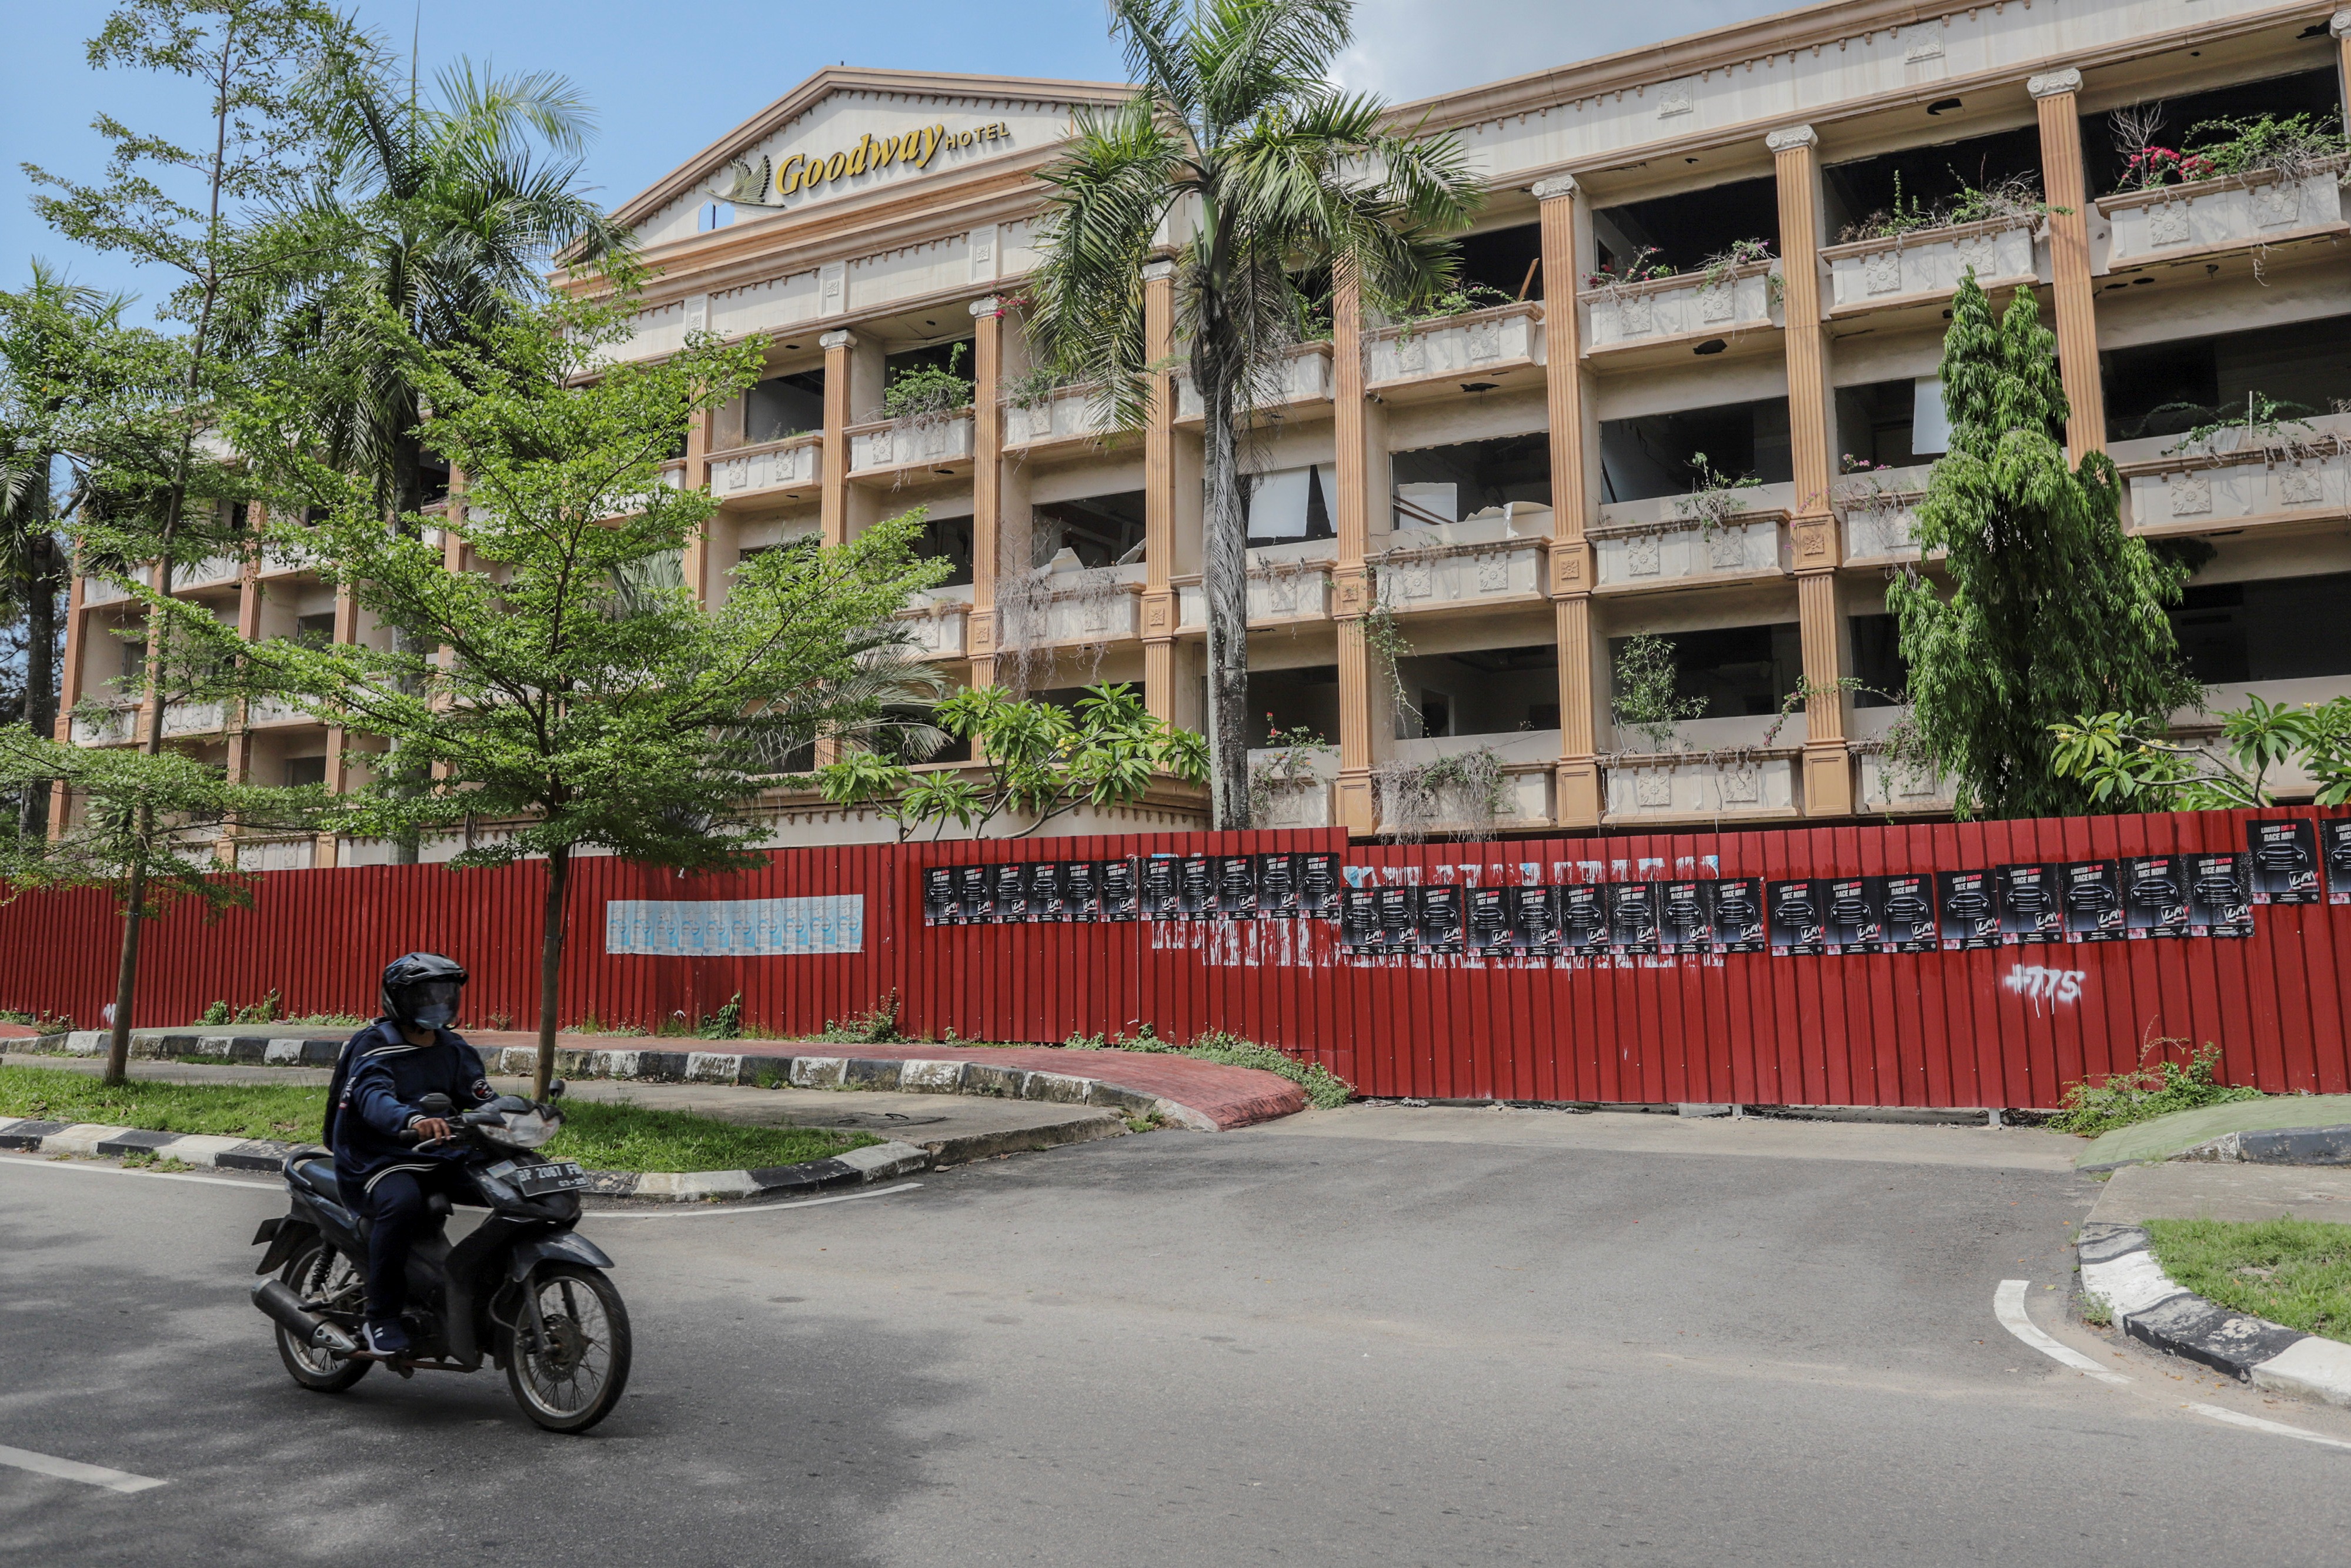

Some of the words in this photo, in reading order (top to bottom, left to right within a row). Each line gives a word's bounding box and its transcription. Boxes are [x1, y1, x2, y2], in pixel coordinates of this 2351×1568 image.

[774, 124, 944, 196] Goodway
[944, 122, 1010, 151] HOTEL
[2264, 833, 2280, 842] RACE
[2281, 831, 2295, 840] NOW!
[2339, 832, 2351, 840] RAC
[2135, 862, 2150, 871] LIMITED
[2216, 865, 2231, 874] NOW!
[2151, 867, 2166, 875] NOW!
[2074, 874, 2089, 882] RACE
[2089, 872, 2102, 881] NOW!
[1967, 881, 1981, 890] NOW!
[1722, 890, 1735, 898] RACE
[1793, 890, 1806, 898] NOW!
[1836, 890, 1849, 898] RACE
[1891, 887, 1905, 895] RACE
[1571, 895, 1582, 903] RACE
[518, 1170, 531, 1181] BP
